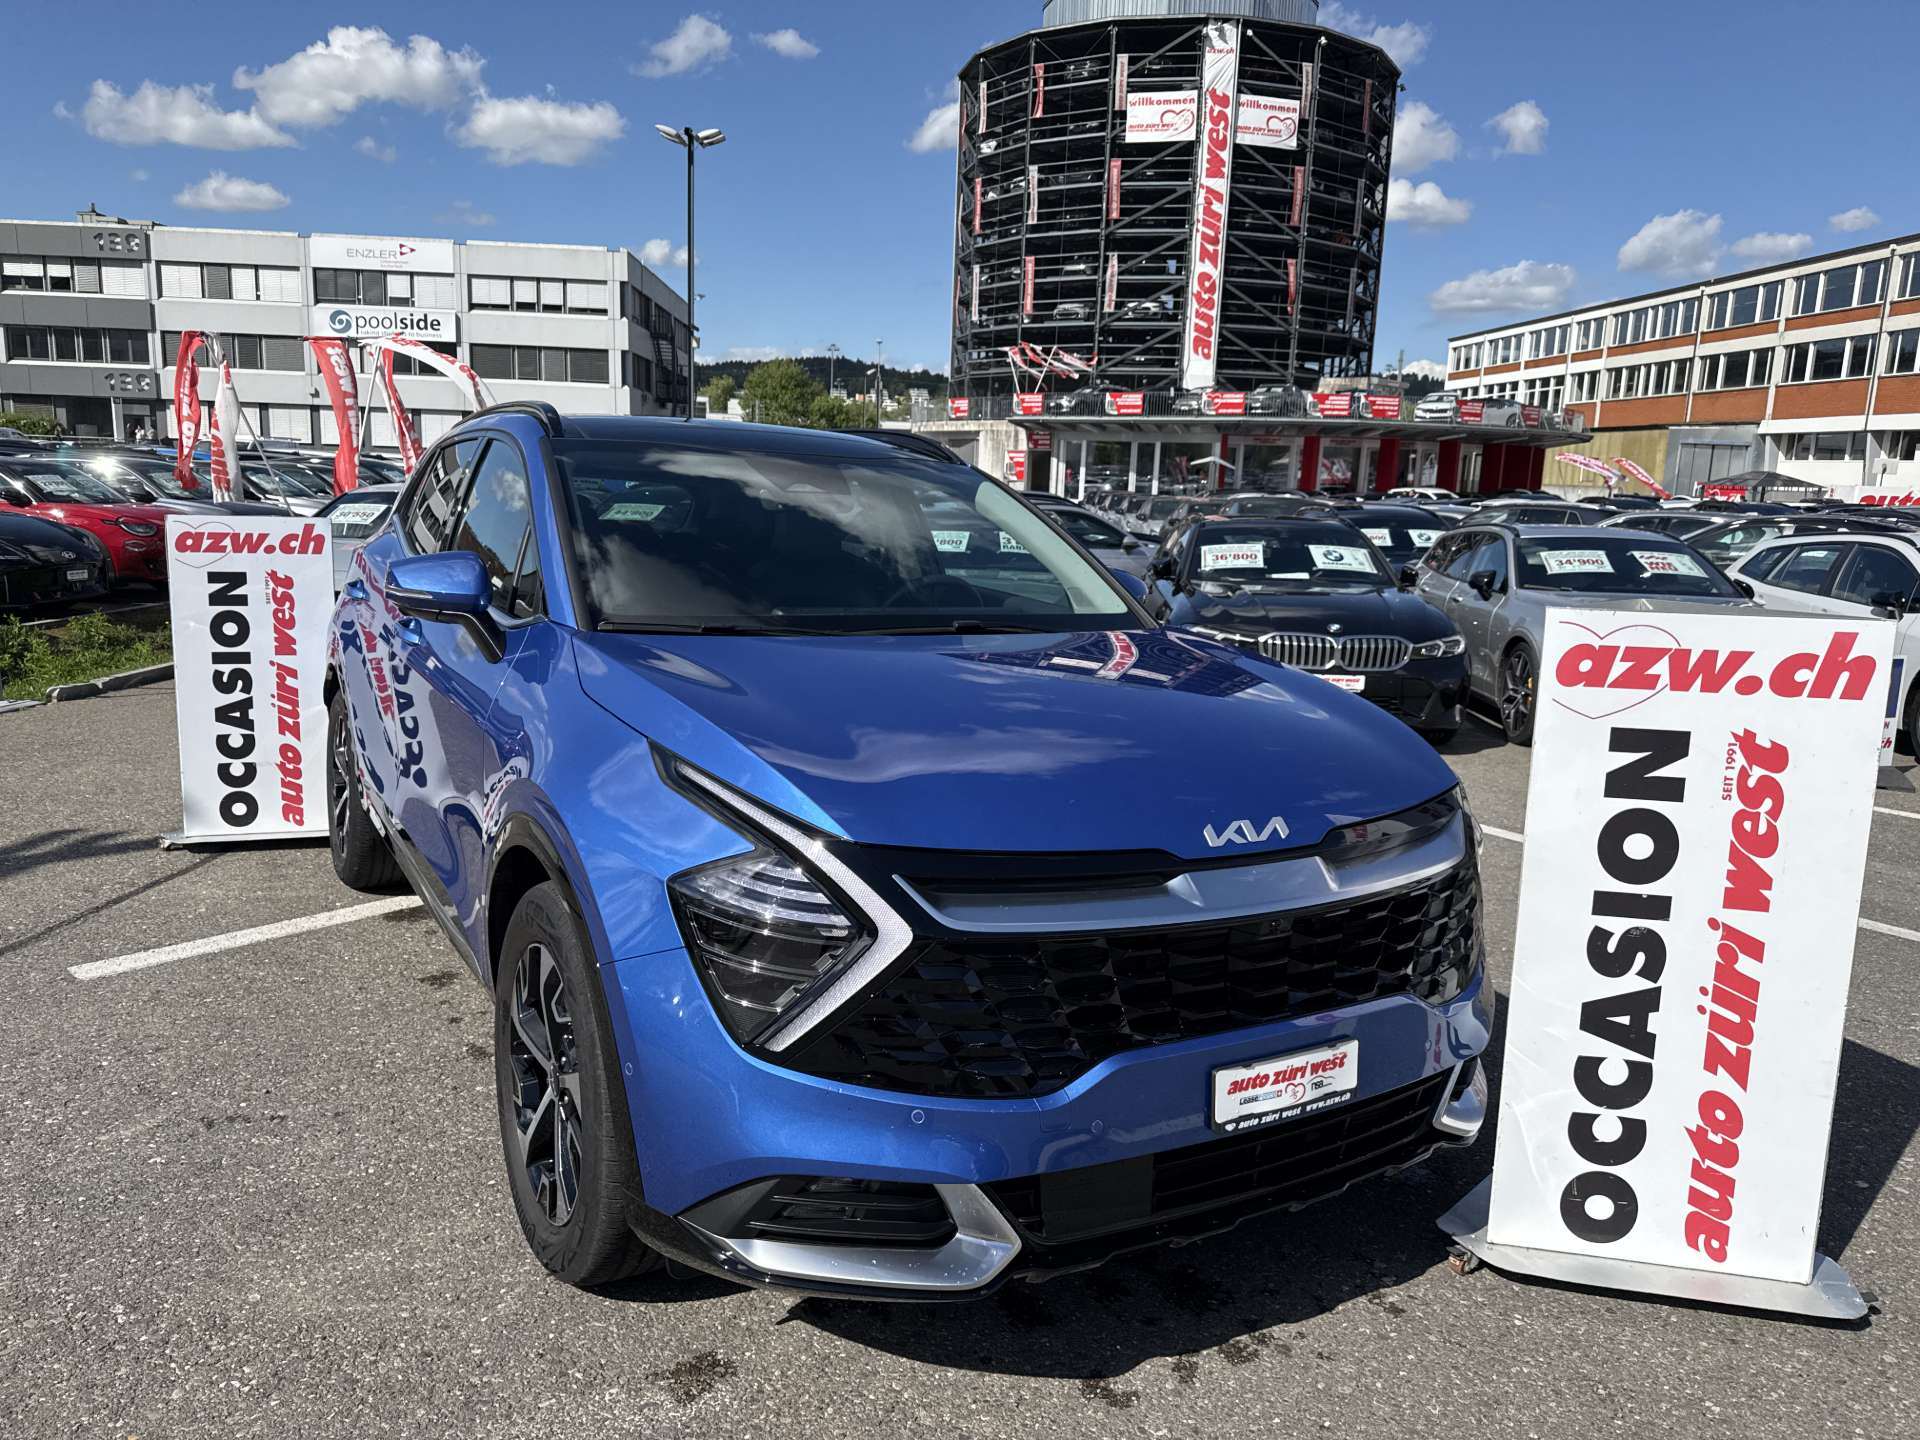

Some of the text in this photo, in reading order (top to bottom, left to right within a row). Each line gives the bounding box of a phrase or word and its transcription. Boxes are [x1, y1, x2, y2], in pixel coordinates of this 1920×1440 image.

[1129, 97, 1196, 107] willkommen
[1238, 99, 1298, 113] willkommen
[1192, 87, 1231, 360] auto züri west
[346, 248, 398, 260] ENZLER
[355, 312, 441, 335] poolside
[174, 524, 326, 555] azw.ch
[1212, 552, 1258, 561] 36'800
[1555, 557, 1605, 567] 34'900
[1555, 630, 1877, 701] azw.ch
[206, 571, 259, 828] OCCASION
[264, 569, 305, 827] auto züri west
[1721, 742, 1738, 801] SEIT 1991
[1203, 816, 1290, 848] KIA
[1559, 726, 1692, 1244] OCCASION
[1684, 727, 1790, 1264] auto züri west
[1227, 1052, 1348, 1096] auto züri west
[1238, 1092, 1351, 1130] auto züri west www.azw.ch
